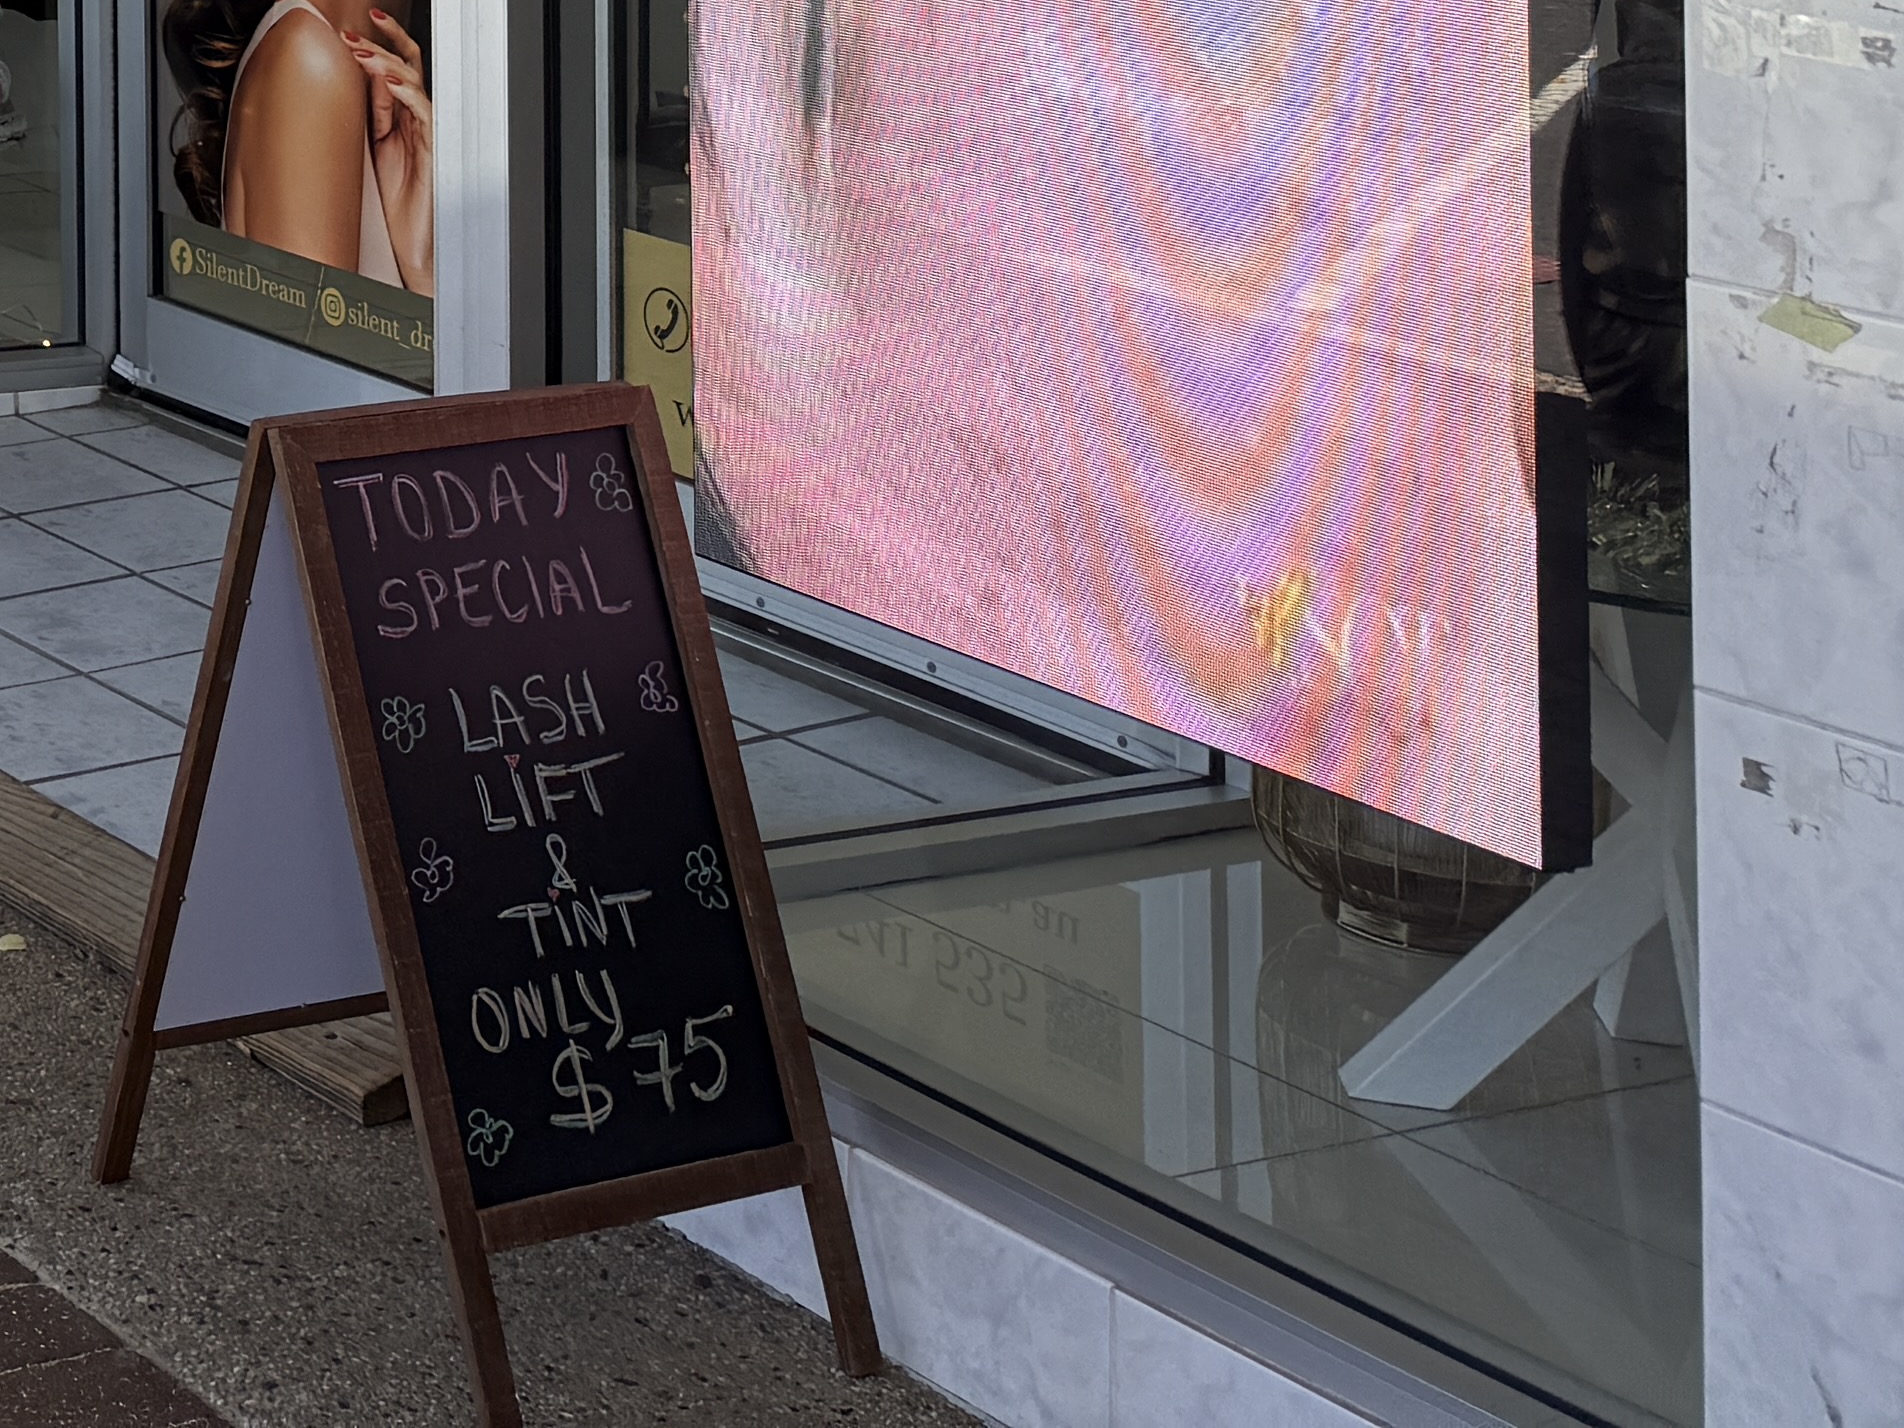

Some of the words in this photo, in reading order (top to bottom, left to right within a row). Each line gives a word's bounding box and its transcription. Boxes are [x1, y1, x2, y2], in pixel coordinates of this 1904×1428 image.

[195, 246, 307, 309] SilentDream
[347, 302, 434, 352] silent_dr
[332, 451, 571, 551] TODAY
[376, 545, 633, 640] SPECIAL
[448, 667, 607, 754] LASH
[470, 968, 628, 1054] ONLY
